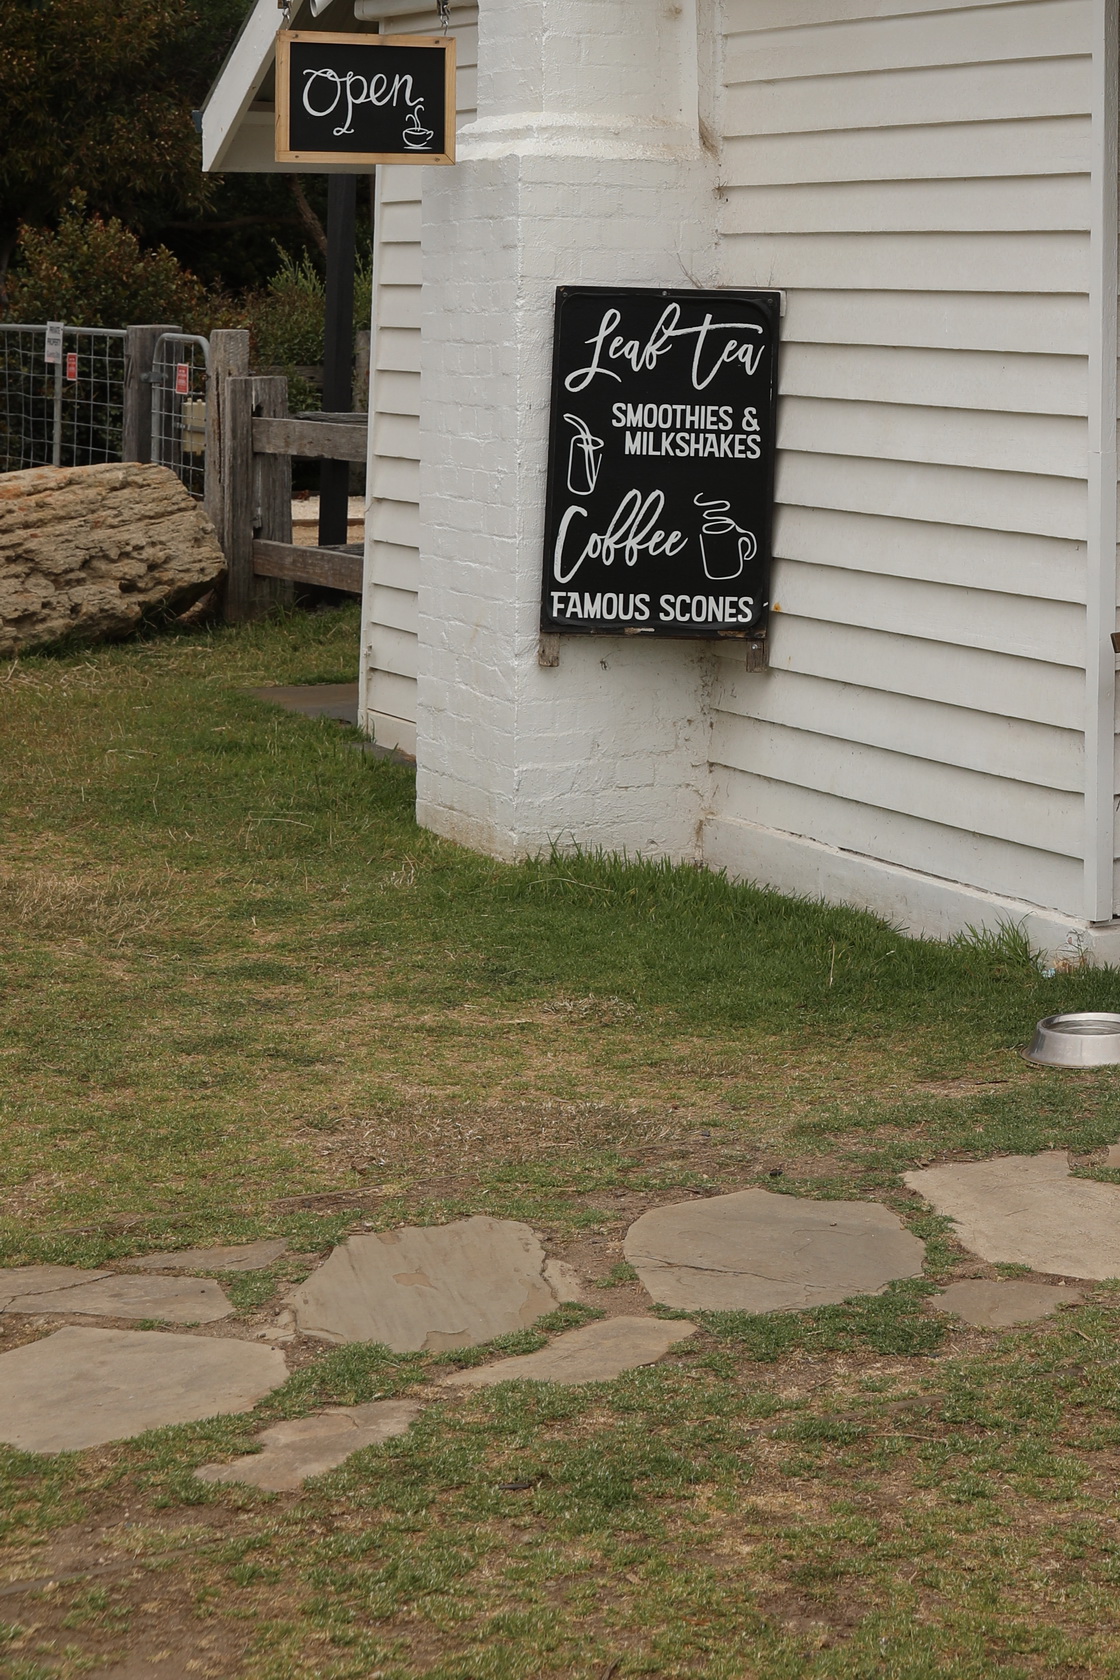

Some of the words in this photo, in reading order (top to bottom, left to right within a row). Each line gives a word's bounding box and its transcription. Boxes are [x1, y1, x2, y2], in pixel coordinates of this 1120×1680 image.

[302, 68, 425, 136] Open
[564, 302, 681, 393] Leaf
[688, 313, 765, 391] tea
[611, 402, 733, 431] SMOOTHIES
[741, 406, 761, 432] &
[624, 430, 761, 459] MILKSHAKES
[553, 488, 688, 584] Coffee
[550, 591, 651, 621] FAMOUS
[659, 594, 754, 623] SCONES
